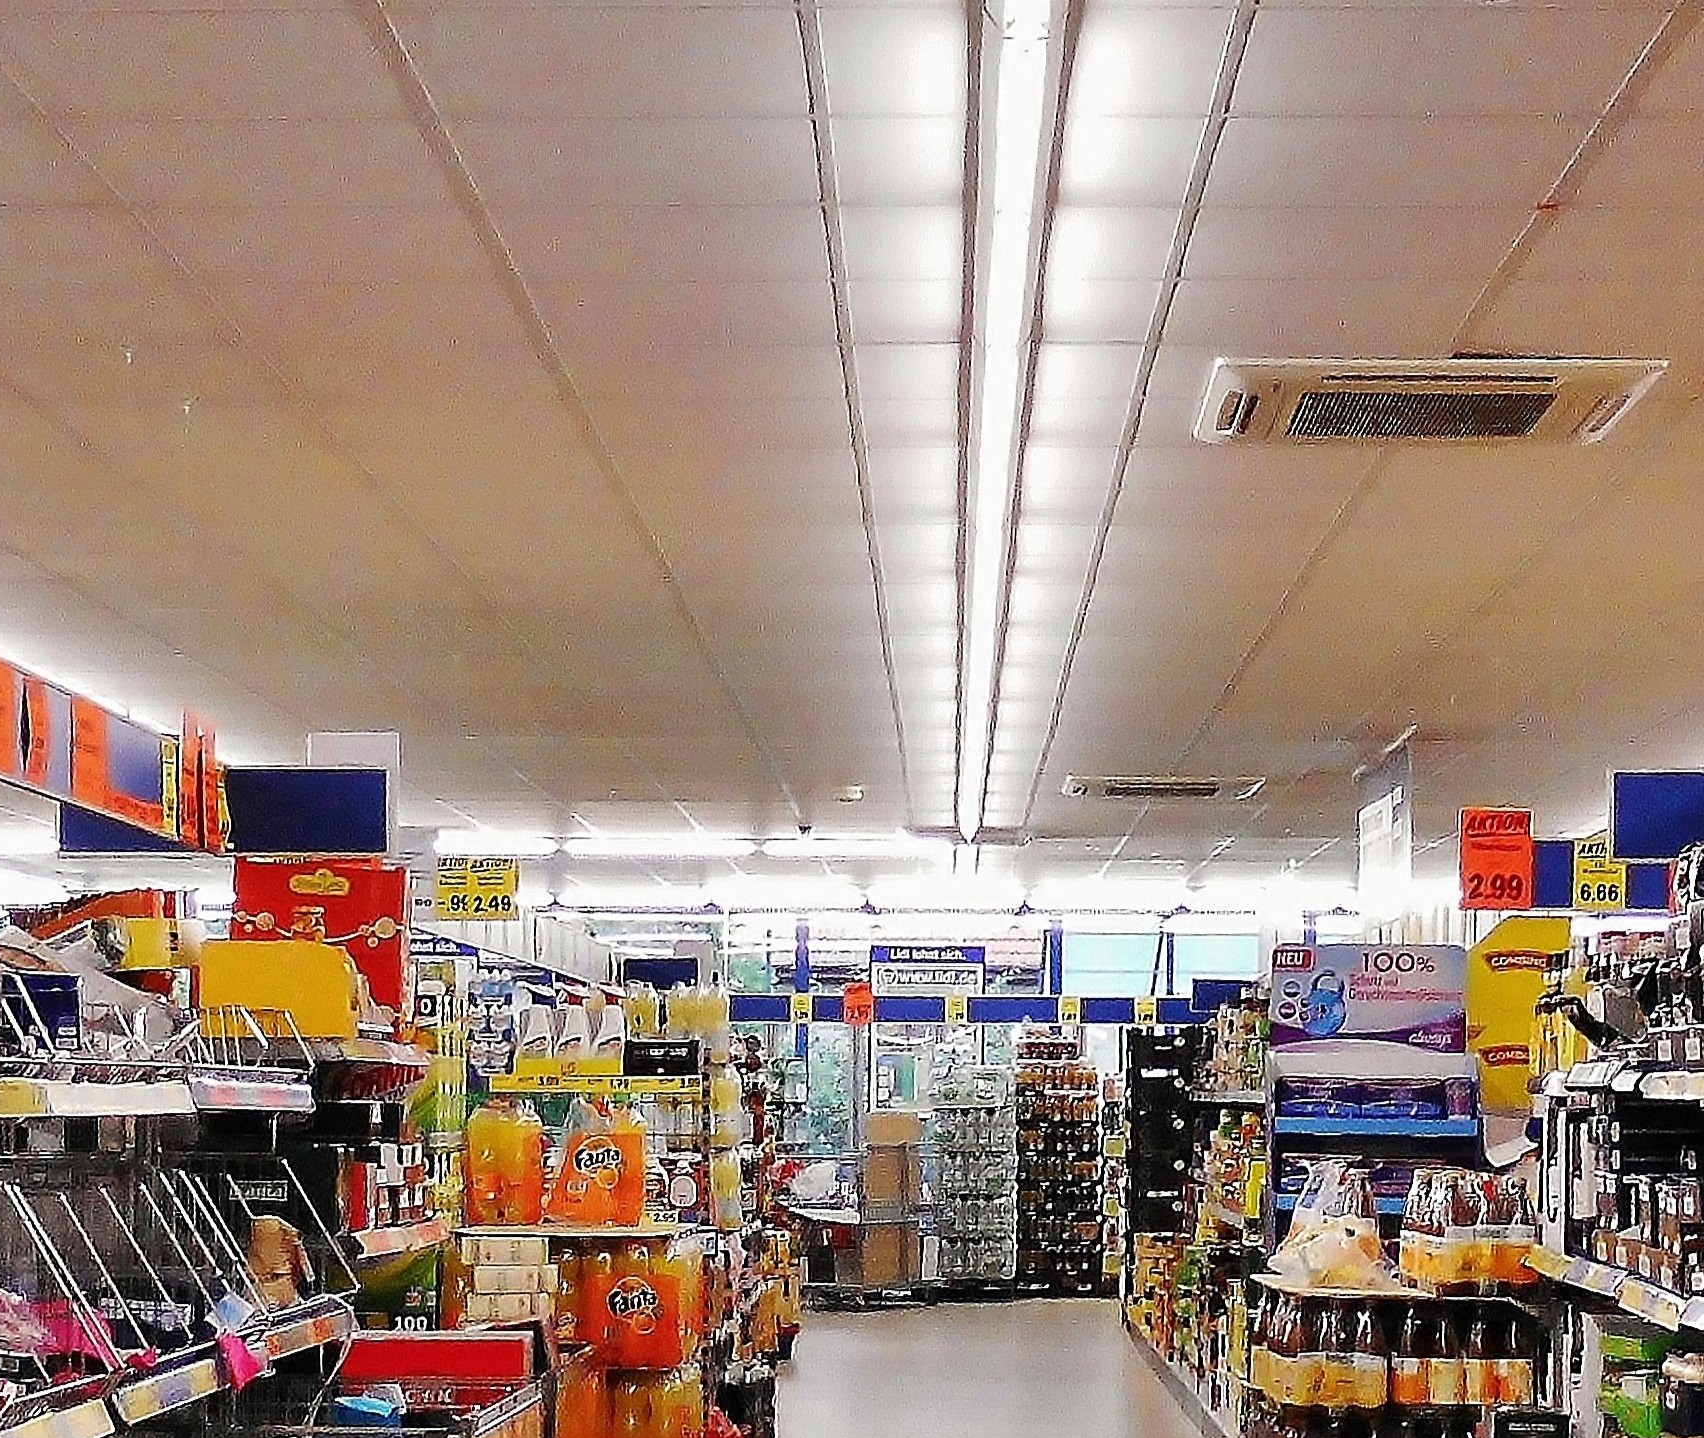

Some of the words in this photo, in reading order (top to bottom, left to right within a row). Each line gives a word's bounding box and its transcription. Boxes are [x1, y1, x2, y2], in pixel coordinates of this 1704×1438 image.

[1468, 874, 1525, 902] 2.99
[1580, 884, 1620, 903] 6.66
[473, 895, 512, 913] 2.49
[1361, 952, 1436, 973] 100%
[573, 1145, 622, 1174] Fanta
[607, 1286, 658, 1316] Fanta
[394, 1315, 429, 1331] 100
